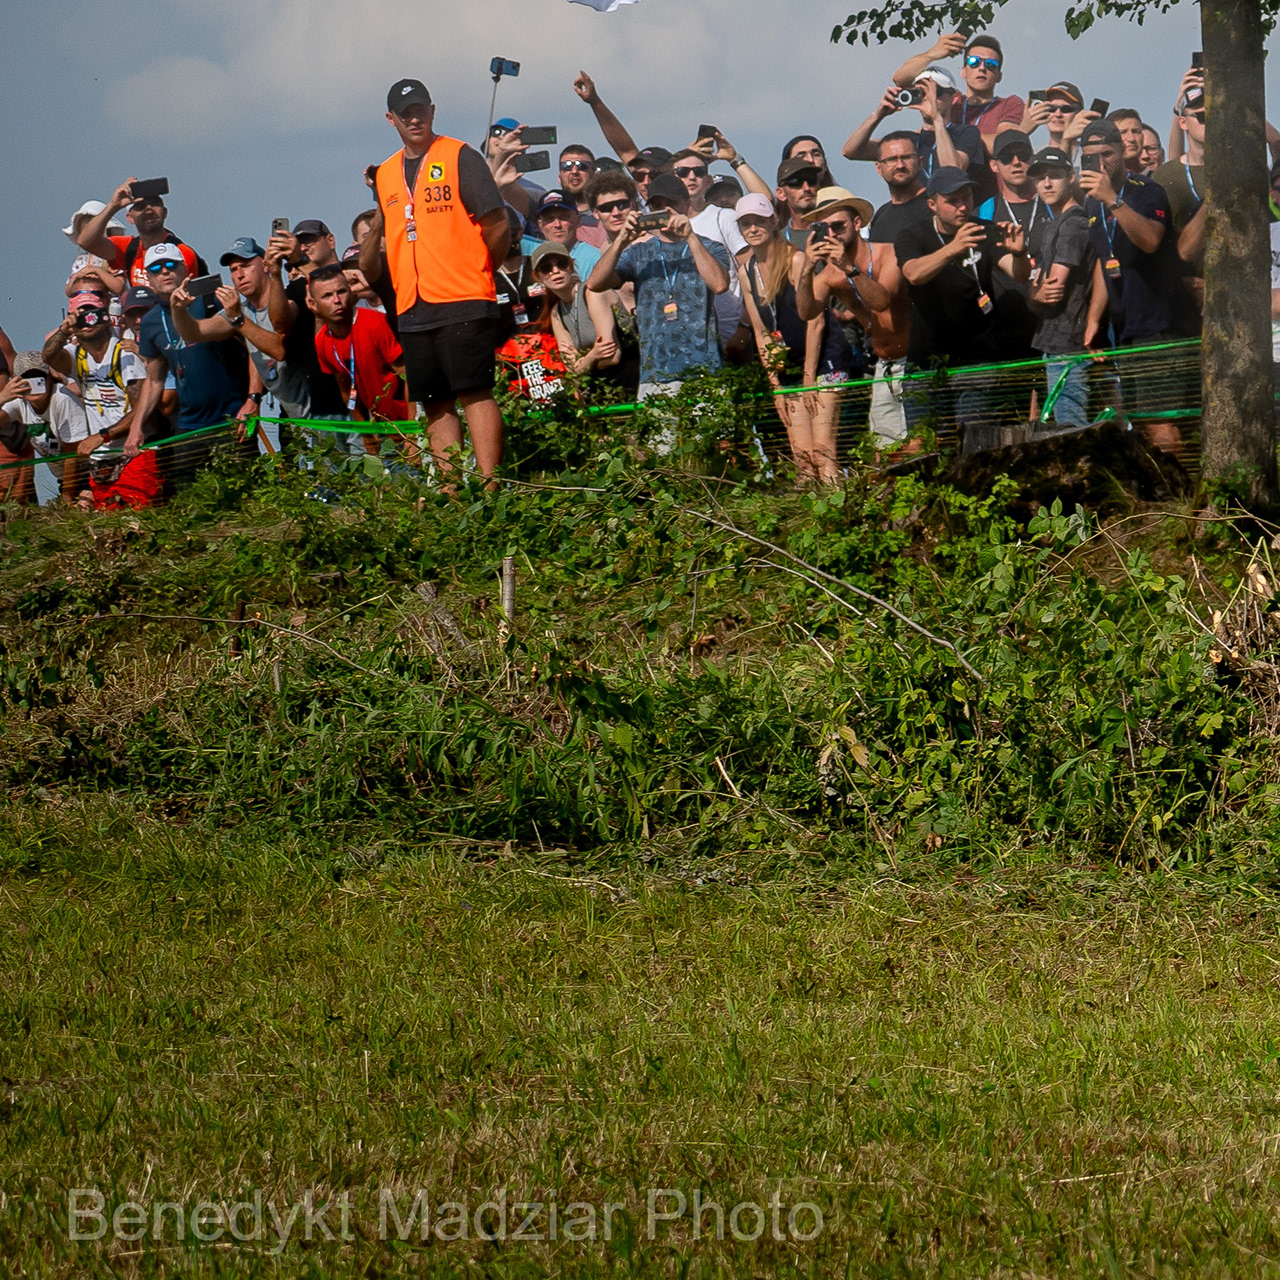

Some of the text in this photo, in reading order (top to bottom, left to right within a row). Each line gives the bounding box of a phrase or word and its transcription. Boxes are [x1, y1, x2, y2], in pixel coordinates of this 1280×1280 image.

[424, 185, 452, 203] 338
[426, 205, 454, 214] SAFETY
[526, 371, 545, 386] THE
